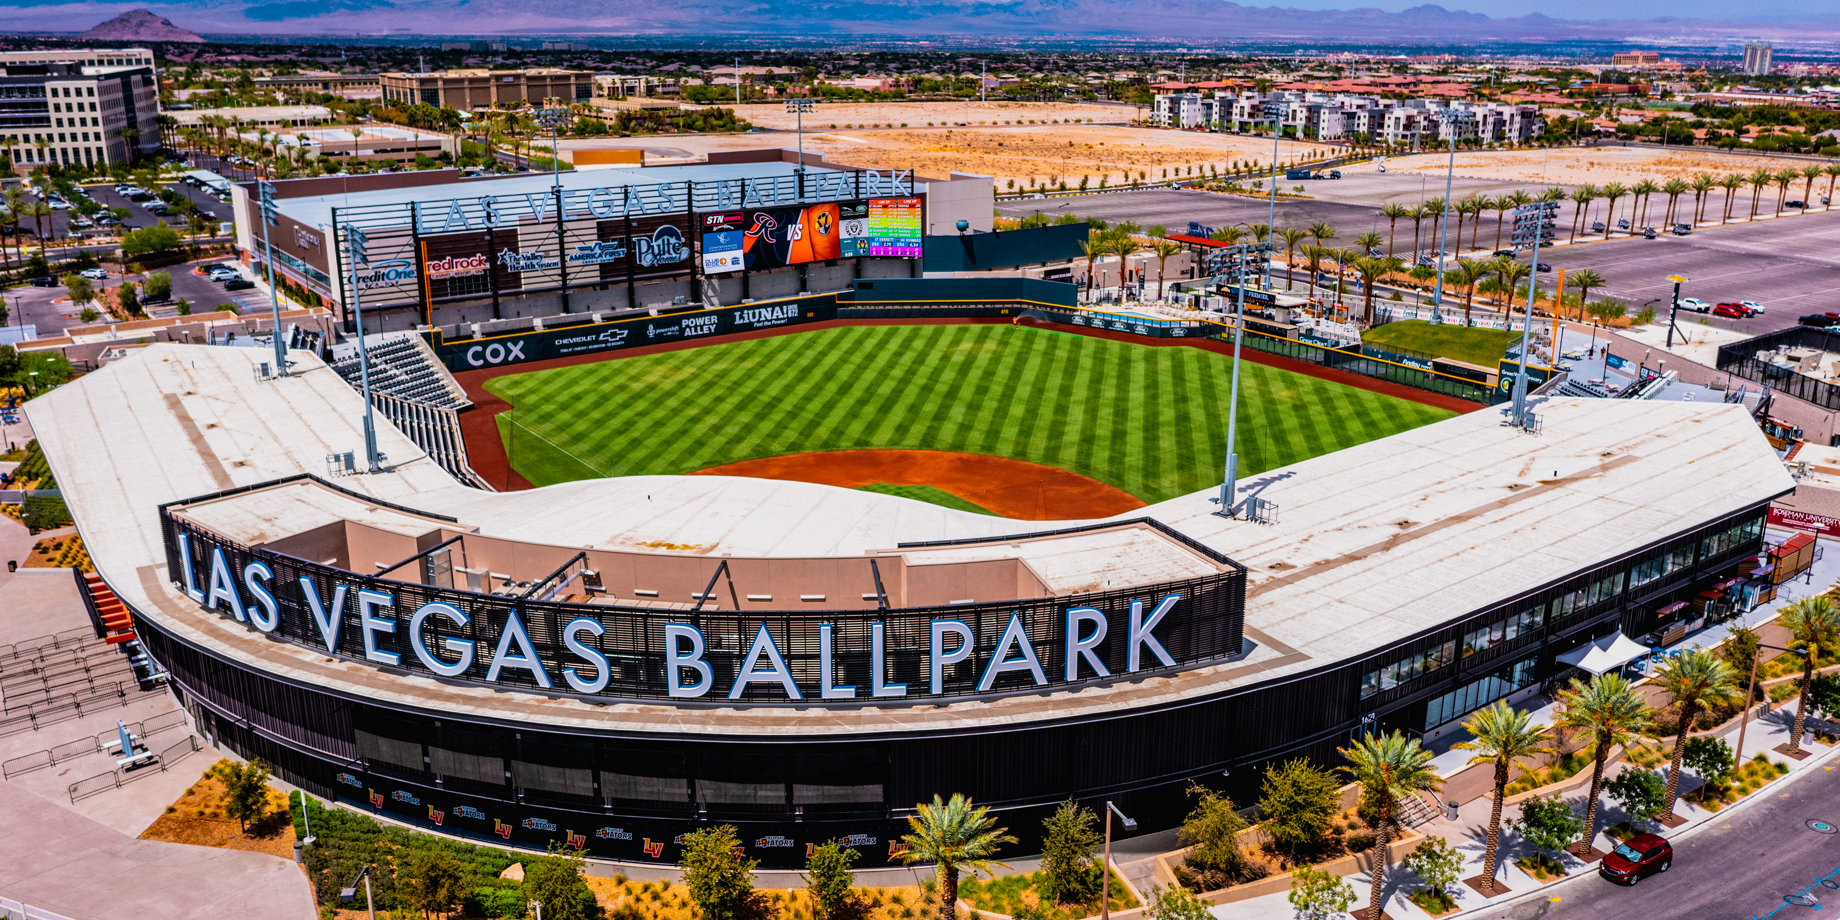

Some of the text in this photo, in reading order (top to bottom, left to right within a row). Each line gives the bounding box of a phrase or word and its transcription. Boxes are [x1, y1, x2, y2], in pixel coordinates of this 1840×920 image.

[416, 169, 912, 233] LAS VEGAS BALLPARK
[706, 215, 724, 224] STN
[787, 224, 803, 241] VS
[508, 251, 544, 262] The Valley
[569, 249, 626, 261] AMERICA FIRST
[635, 238, 682, 263] Pulte
[427, 254, 487, 271] red rock
[509, 259, 559, 271] Health System
[648, 254, 682, 266] Homes
[363, 280, 400, 290] BANK
[734, 305, 787, 324] LiUNA!
[788, 309, 798, 318] 872
[682, 315, 718, 328] POWER
[684, 324, 716, 336] ALLEY
[555, 335, 596, 345] CHEVROLET
[467, 340, 525, 366] COX
[1402, 359, 1420, 369] Findlay
[1528, 375, 1542, 384] rocery
[1773, 508, 1804, 519] ROSEMAN
[178, 532, 1181, 700] LAS VEGAS BALLPARK
[368, 788, 384, 808] LV
[427, 804, 445, 825] LV
[494, 818, 512, 839] LV
[566, 829, 586, 849] LV
[642, 837, 664, 858] LV
